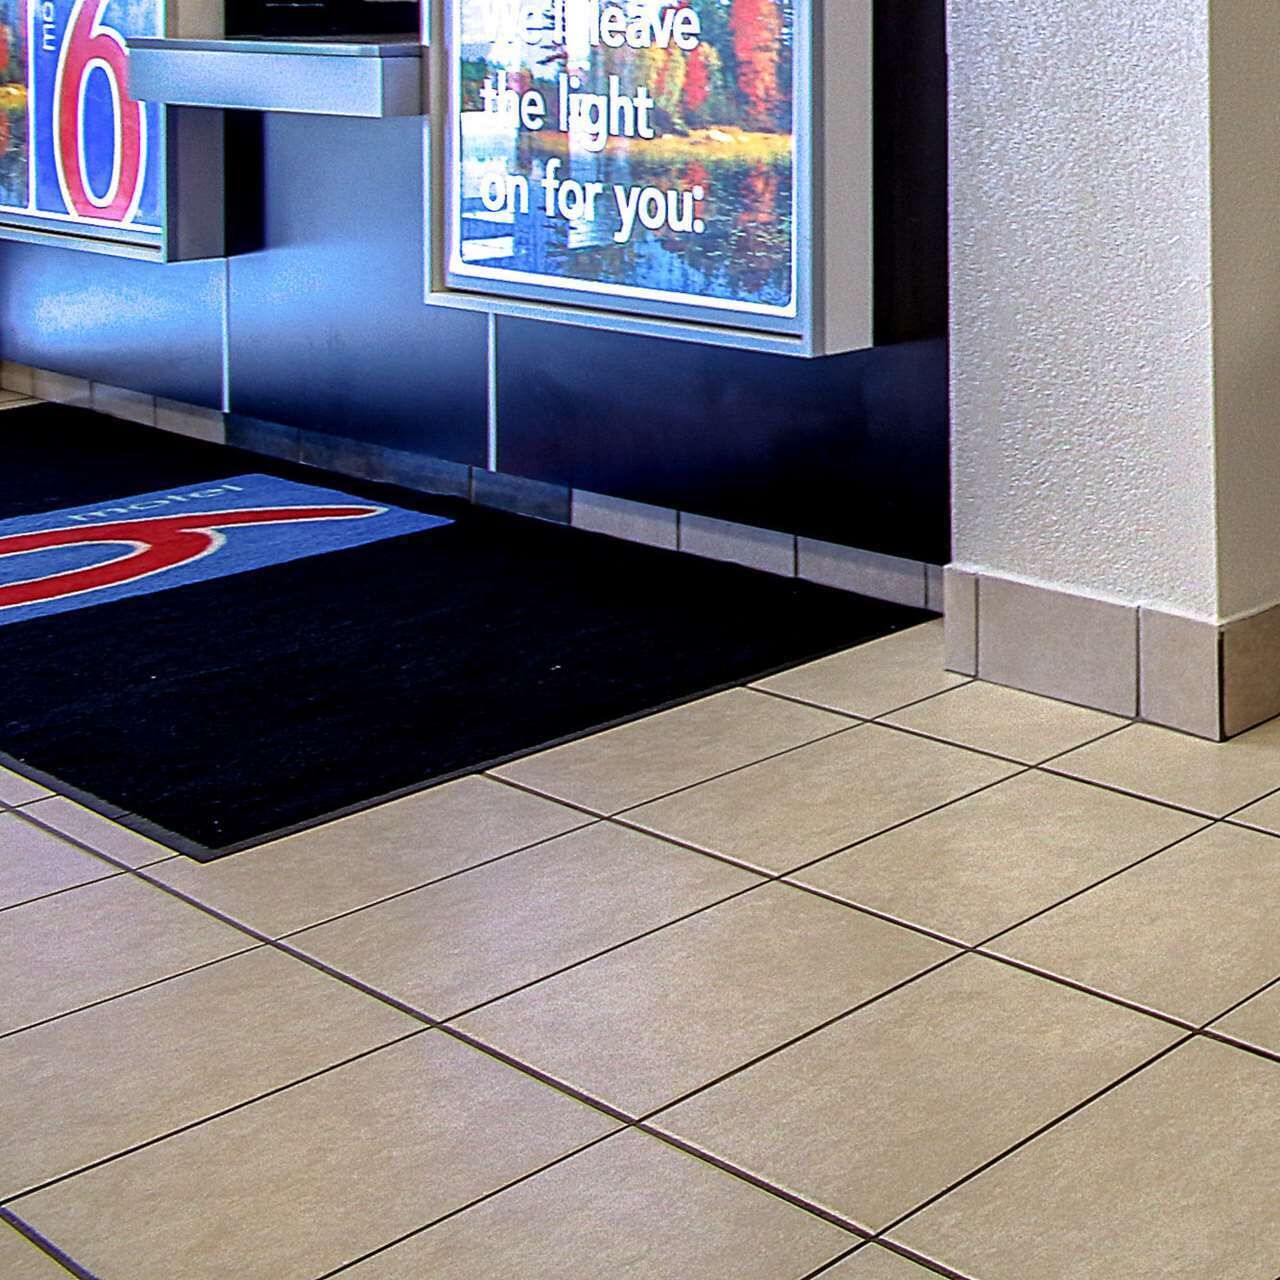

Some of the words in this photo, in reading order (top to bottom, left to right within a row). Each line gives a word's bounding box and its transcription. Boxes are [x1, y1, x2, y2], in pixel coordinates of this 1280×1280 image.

[479, 70, 546, 132] the
[558, 72, 656, 153] light
[480, 172, 529, 214] on
[541, 157, 603, 221] for
